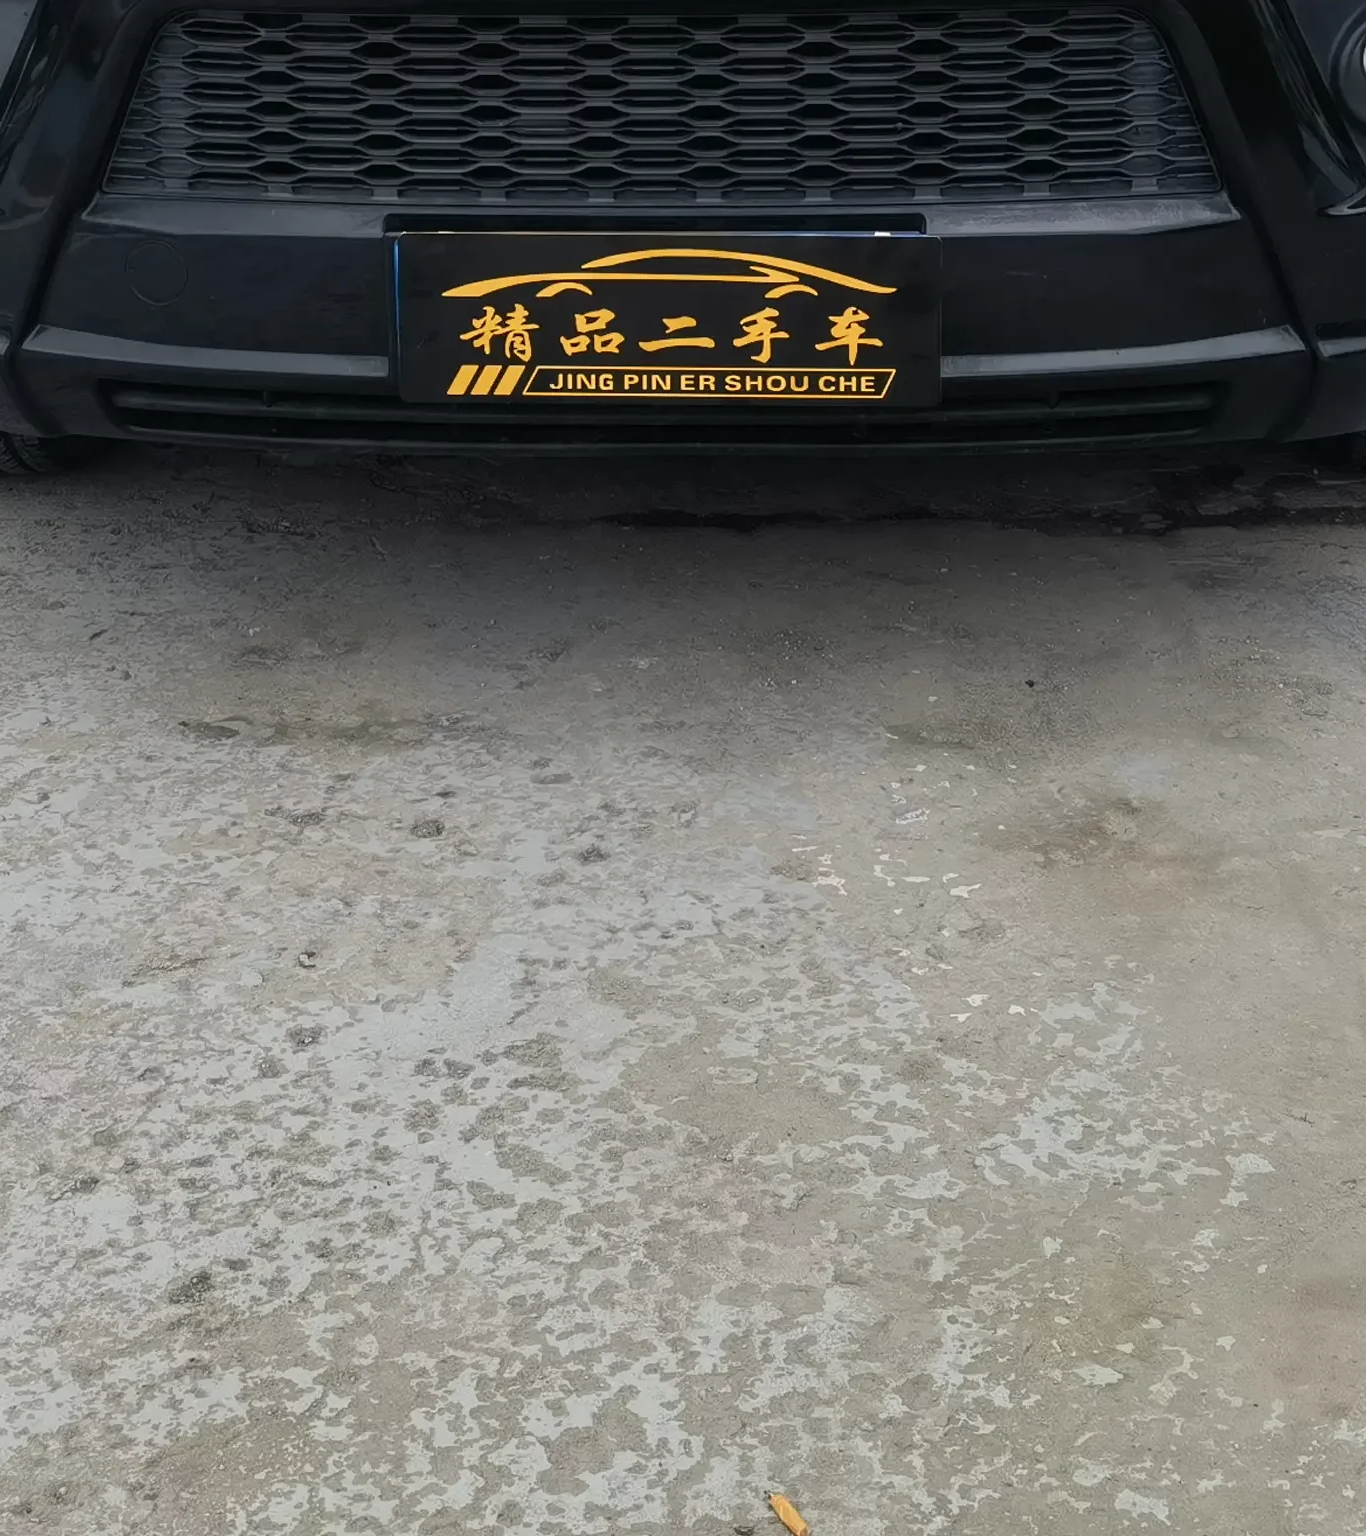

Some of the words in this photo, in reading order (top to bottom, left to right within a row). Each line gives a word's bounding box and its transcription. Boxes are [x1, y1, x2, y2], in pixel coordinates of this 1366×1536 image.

[459, 303, 883, 365] 精品二手车
[549, 373, 614, 391] JING
[624, 374, 671, 391] PIN
[680, 374, 716, 391] ER
[724, 375, 809, 392] SHOU
[818, 375, 876, 392] CHE
